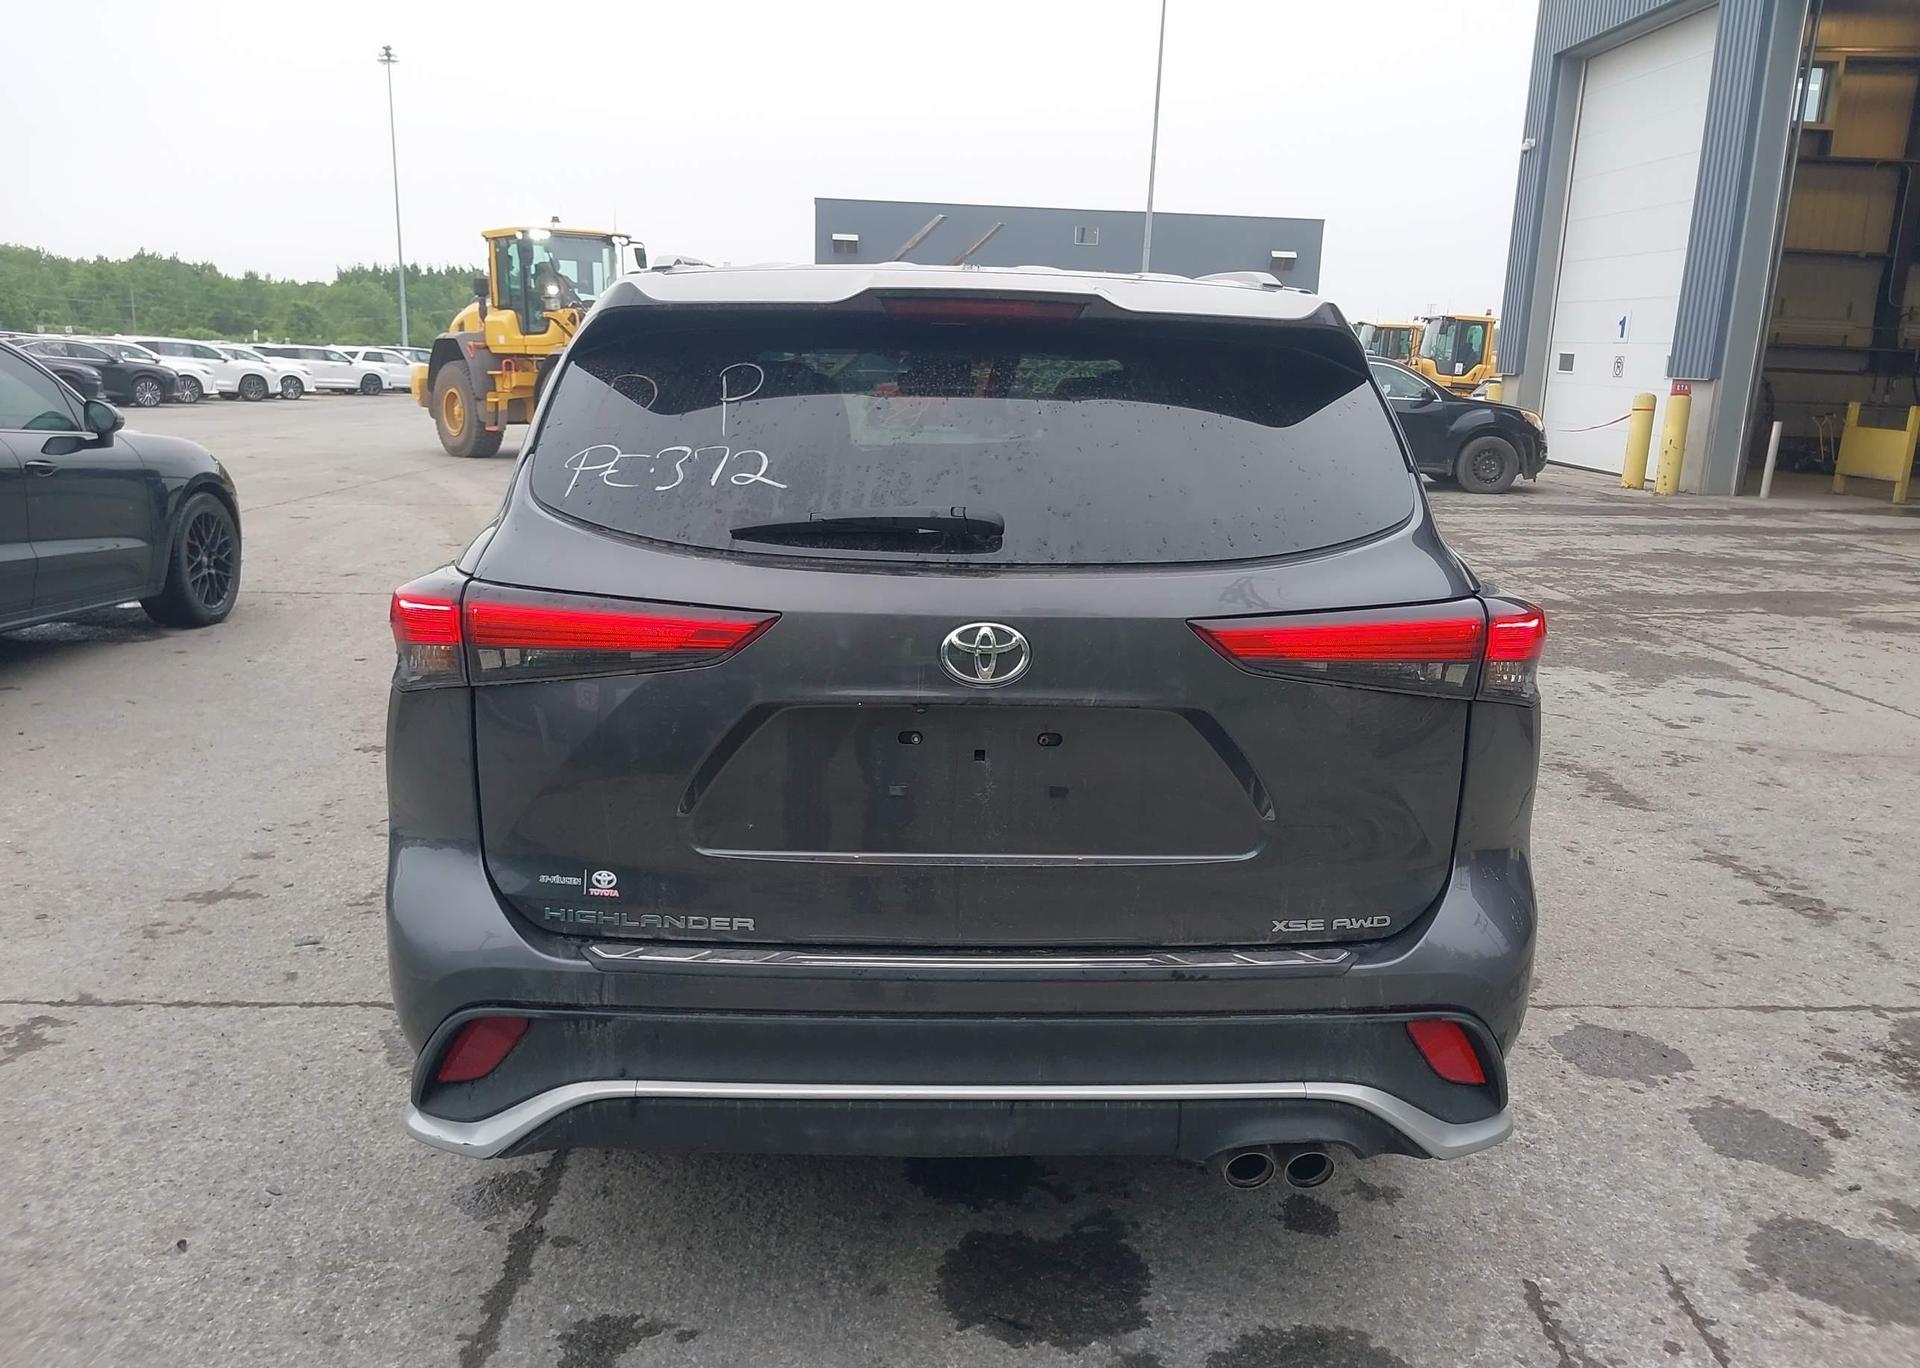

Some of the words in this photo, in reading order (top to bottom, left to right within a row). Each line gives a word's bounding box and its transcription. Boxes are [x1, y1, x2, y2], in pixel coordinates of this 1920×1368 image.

[1618, 316, 1627, 338] 1
[720, 362, 765, 437] P
[589, 888, 620, 897] TOYOTA
[544, 906, 756, 932] HIGHLANDER
[1271, 920, 1325, 933] XSE
[1332, 915, 1392, 930] AWD
